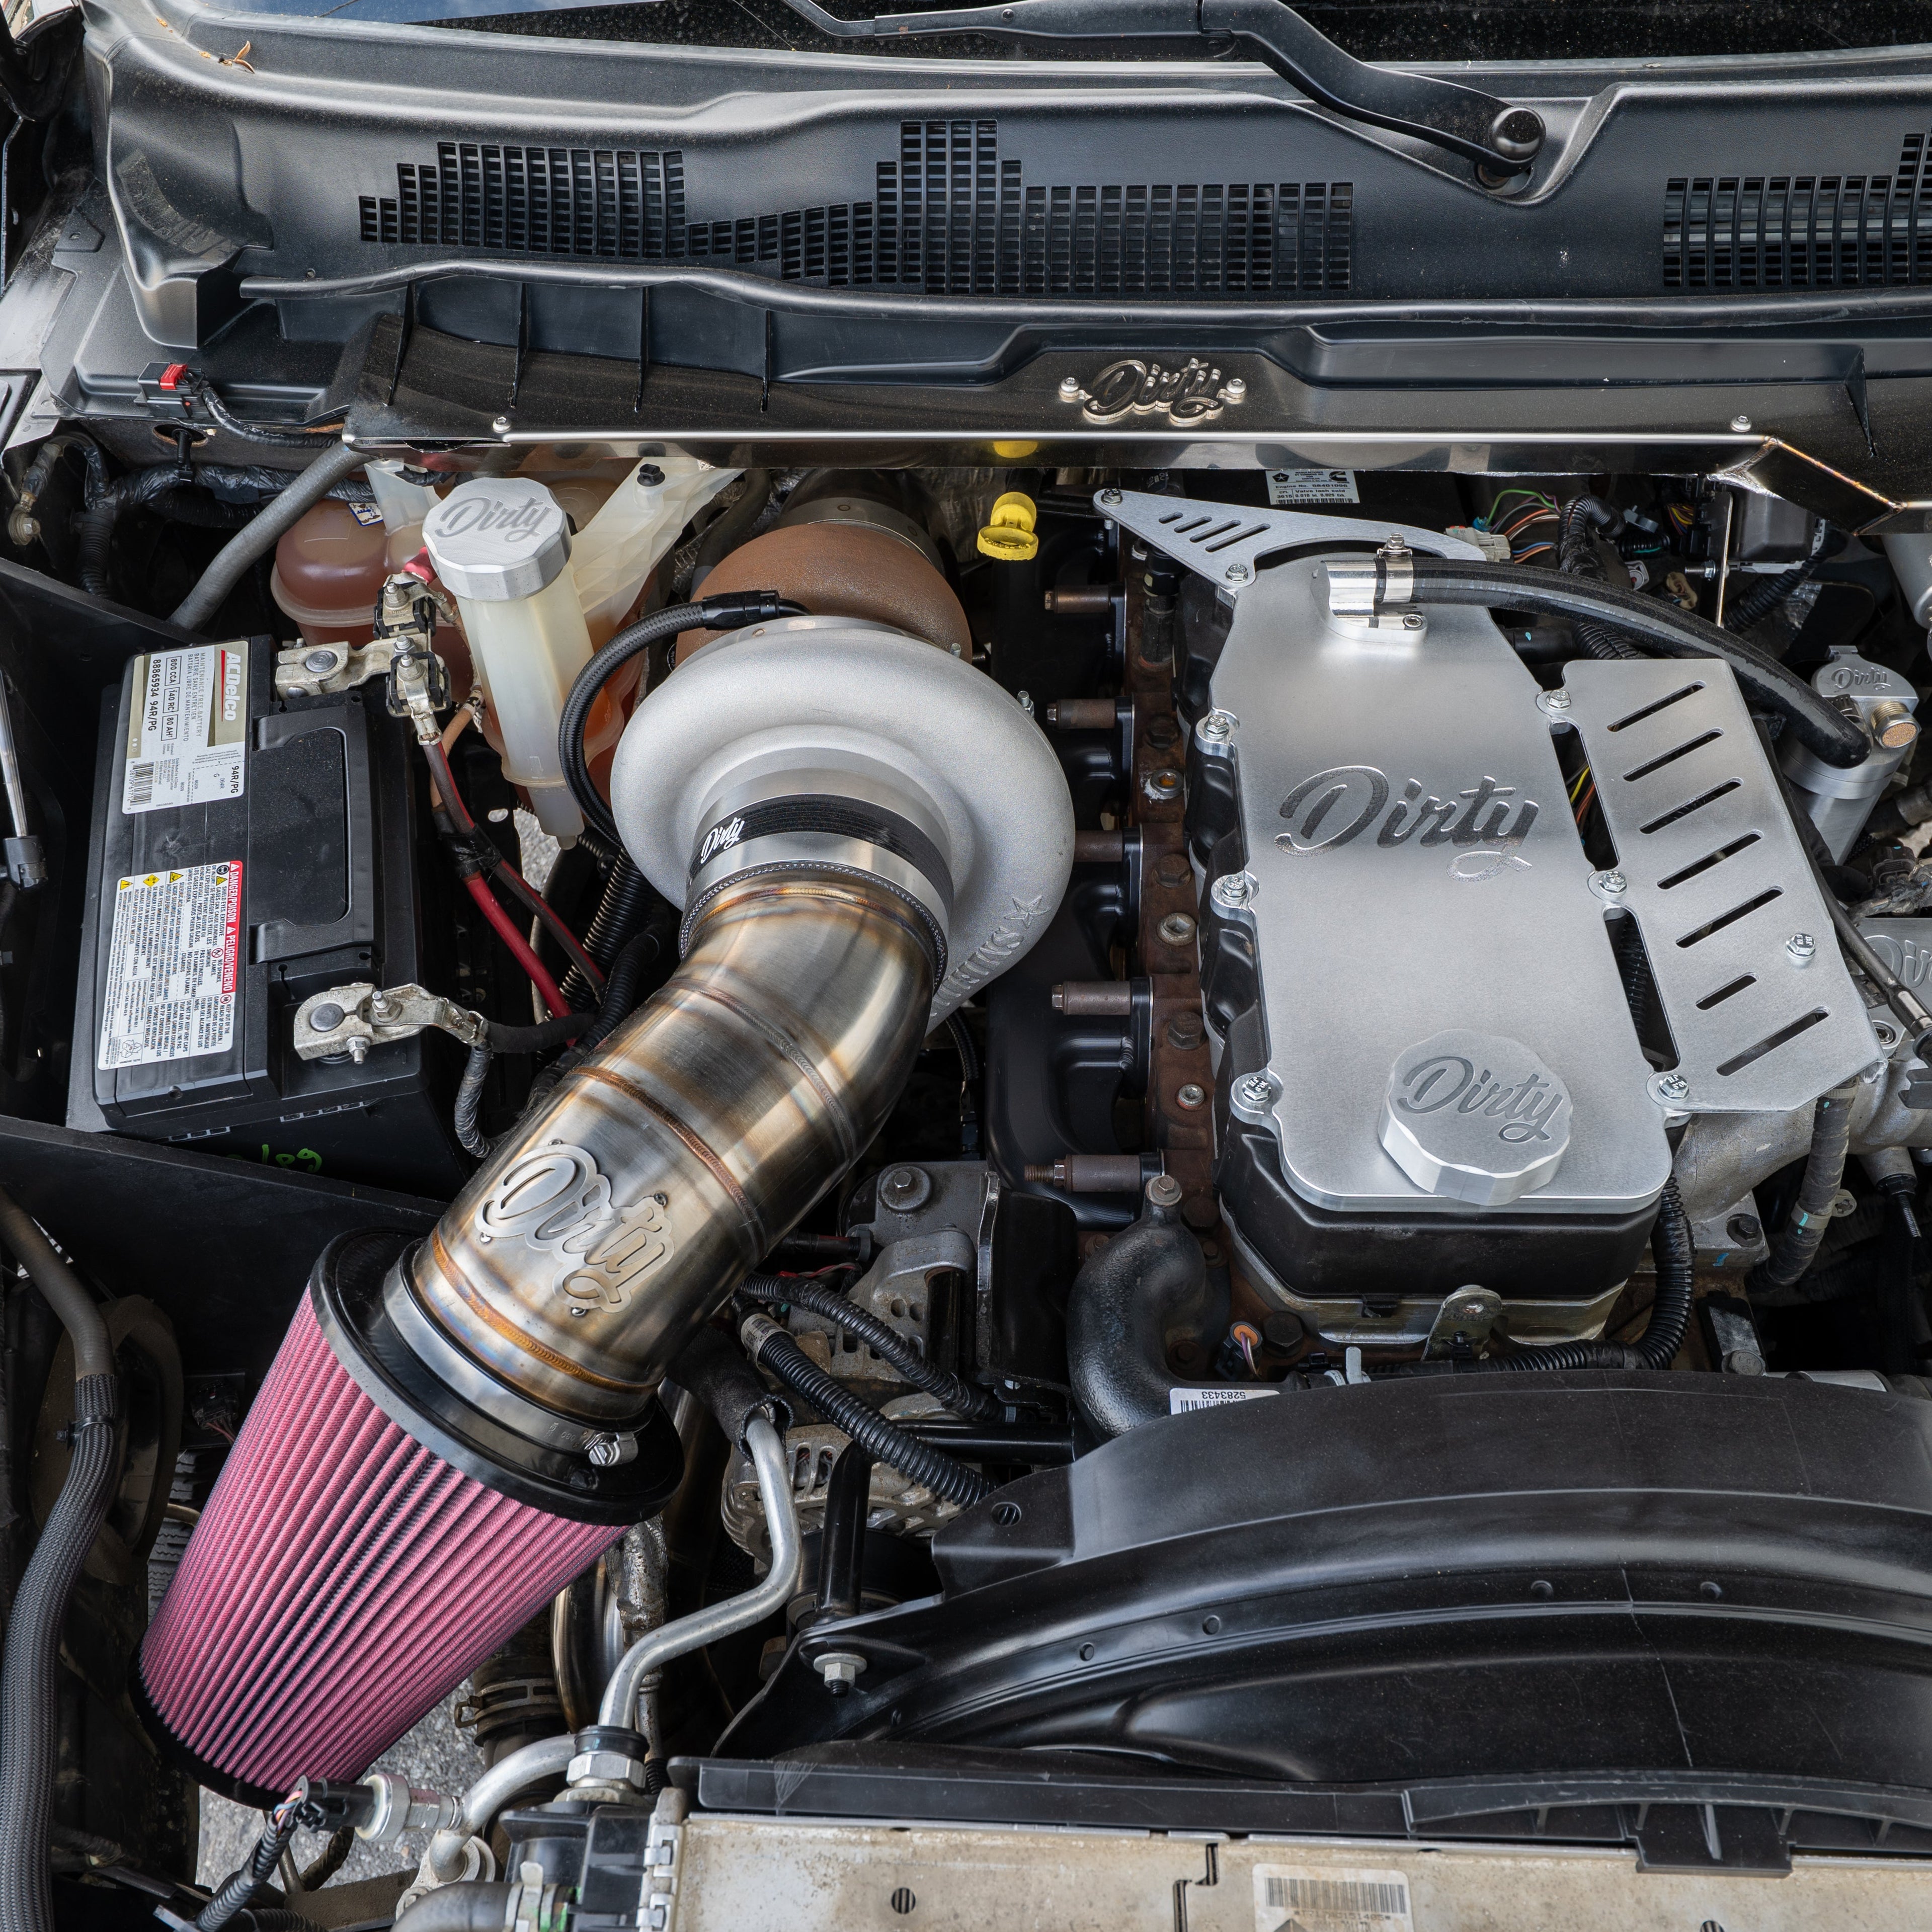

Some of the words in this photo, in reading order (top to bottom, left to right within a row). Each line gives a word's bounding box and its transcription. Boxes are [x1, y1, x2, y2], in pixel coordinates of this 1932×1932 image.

[1083, 358, 1223, 427] Dirty
[435, 498, 552, 541] Dirty
[150, 659, 161, 697] 88865934
[224, 650, 242, 721] ACDelco
[1831, 667, 1891, 690] Dirty
[146, 700, 158, 732] 94R/PG
[166, 717, 174, 725] 80
[229, 765, 239, 794] 94R/PG
[700, 818, 746, 863] Dirty
[1273, 764, 1540, 882] Dirty
[226, 870, 239, 923] DANGER/POISON
[222, 934, 235, 992] PELIGRO/VENENO
[1397, 1056, 1563, 1144] Dirty
[479, 1151, 667, 1306] Dirty
[1201, 1391, 1246, 1399] 5283433
